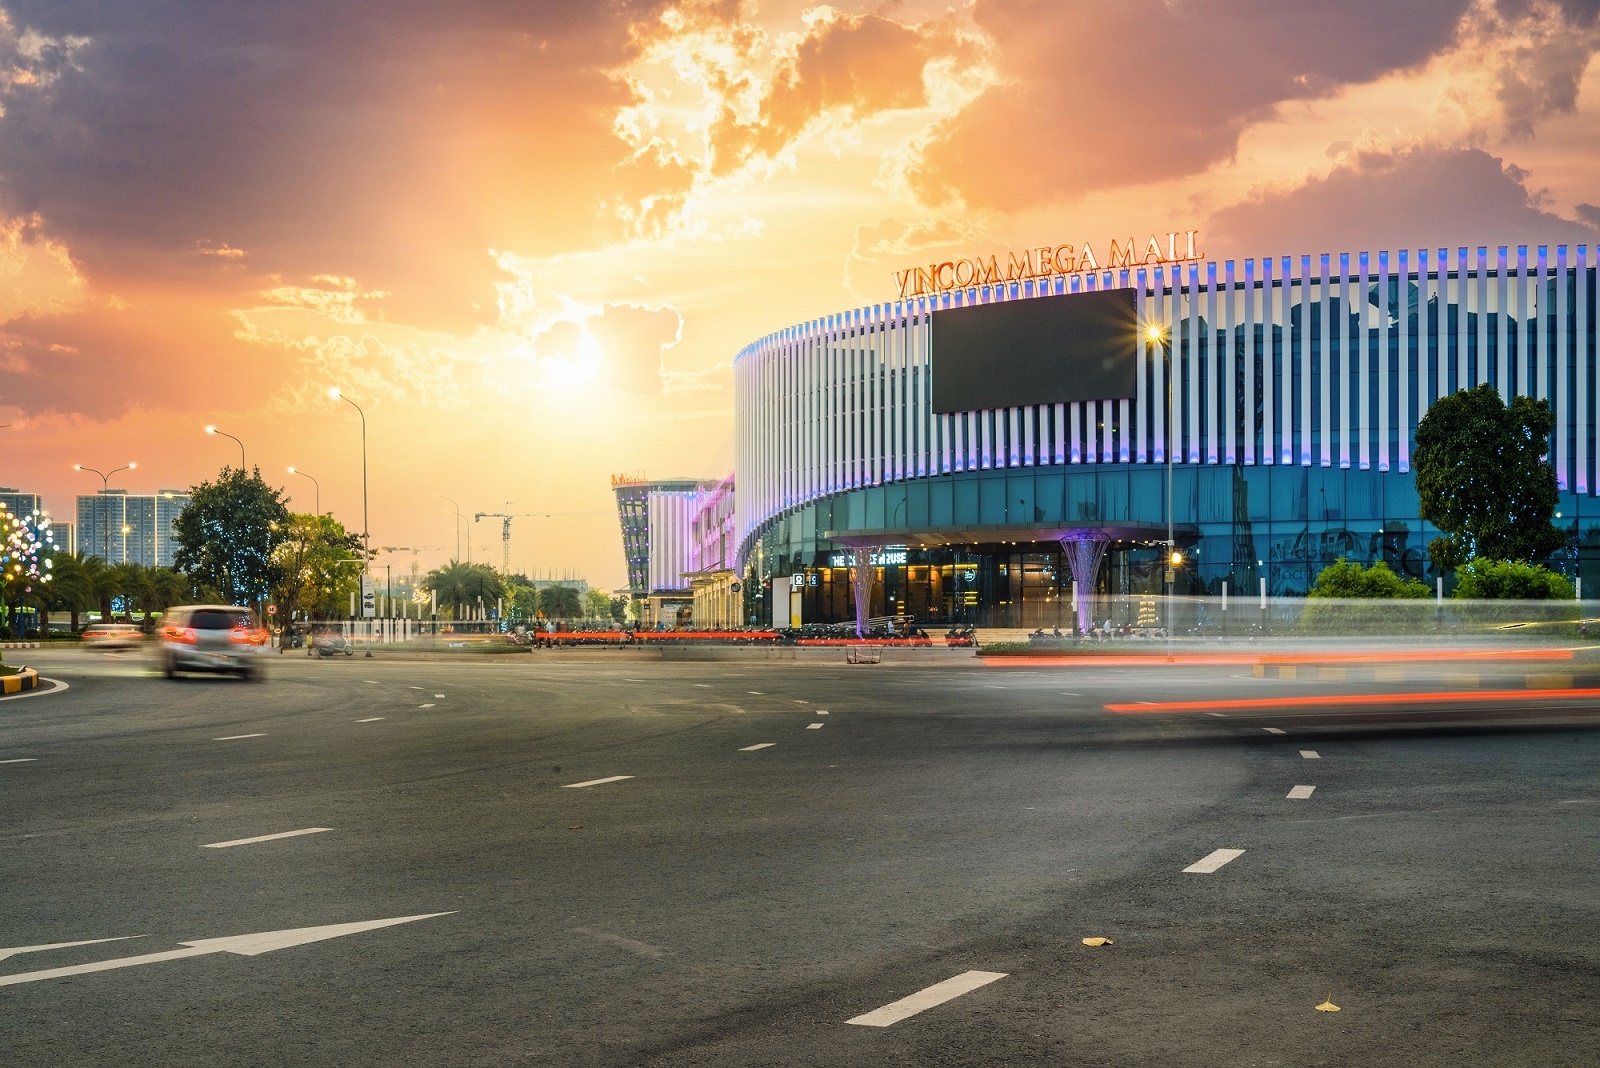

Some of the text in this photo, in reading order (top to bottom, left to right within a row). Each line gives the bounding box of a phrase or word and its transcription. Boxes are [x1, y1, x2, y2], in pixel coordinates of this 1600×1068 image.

[892, 230, 1206, 297] VINCOM MEGA MALL
